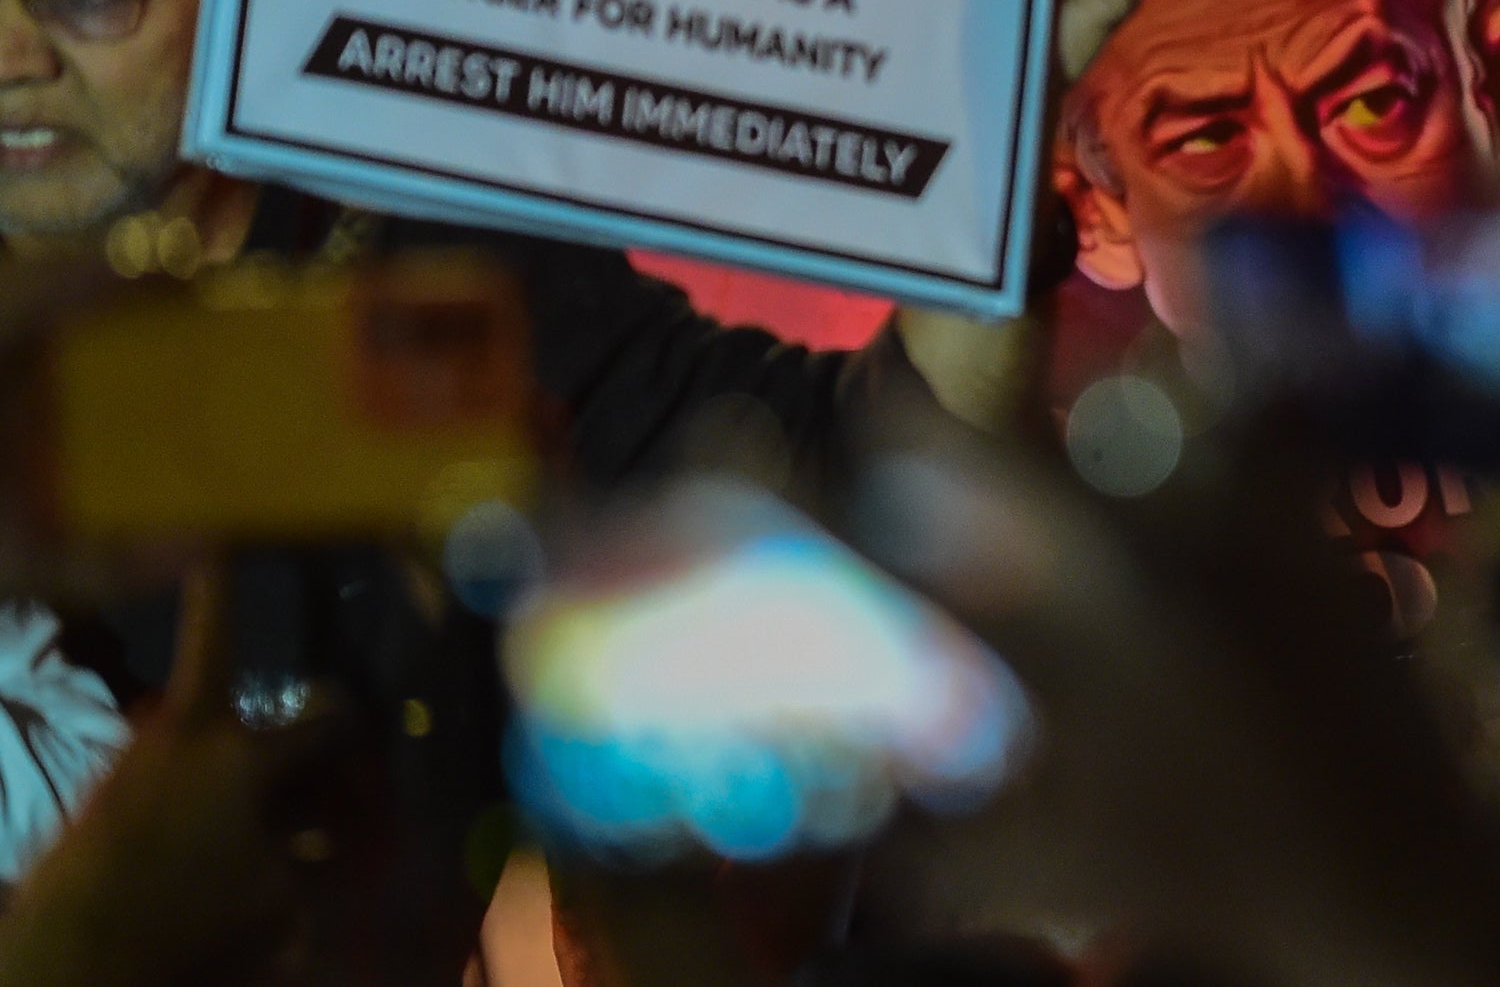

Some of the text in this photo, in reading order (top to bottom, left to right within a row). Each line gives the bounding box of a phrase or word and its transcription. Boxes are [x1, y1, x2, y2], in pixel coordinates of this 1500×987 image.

[668, 5, 889, 84] HUMANITY
[338, 28, 918, 185] ARREST HIM IMMEDIATELY
